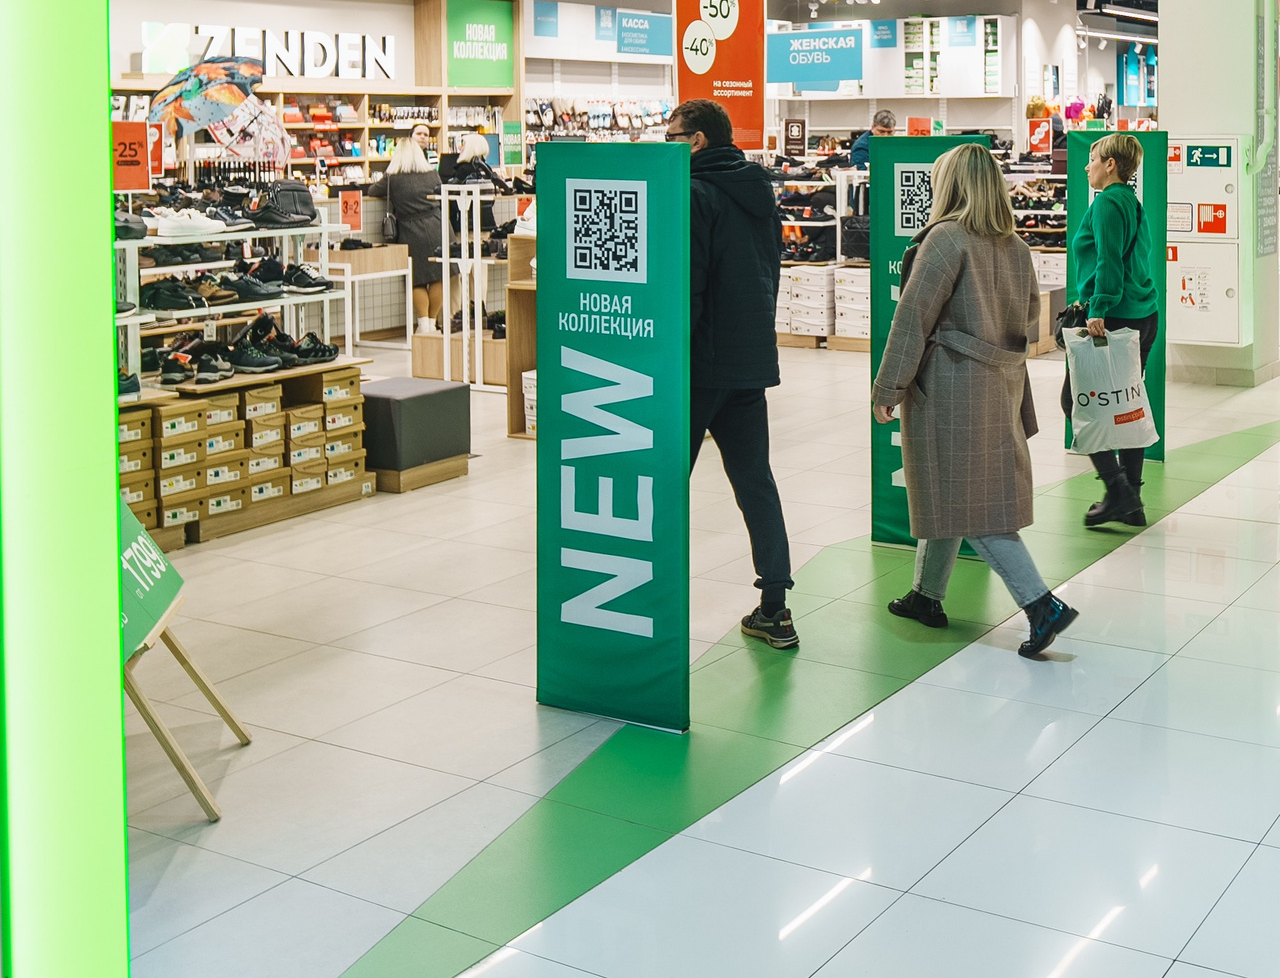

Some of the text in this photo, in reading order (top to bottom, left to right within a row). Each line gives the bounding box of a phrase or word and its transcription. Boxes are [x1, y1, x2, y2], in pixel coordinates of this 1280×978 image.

[465, 23, 495, 41] НОВАЯ
[621, 17, 650, 30] КАССА
[453, 41, 508, 61] КОЛЛЕКЦИЯ
[684, 38, 714, 57] -40%
[789, 36, 855, 51] ЖЕНСКАЯ
[789, 52, 831, 65] ОБУВЬ
[713, 79, 753, 89] на сезонный
[713, 89, 753, 98] ассортимент
[342, 201, 360, 214] 3=2
[579, 292, 632, 314] НОВАЯ
[558, 312, 654, 340] КОЛЛЕКЦИЯ
[560, 345, 654, 639] NEW
[120, 535, 166, 592] 1799
